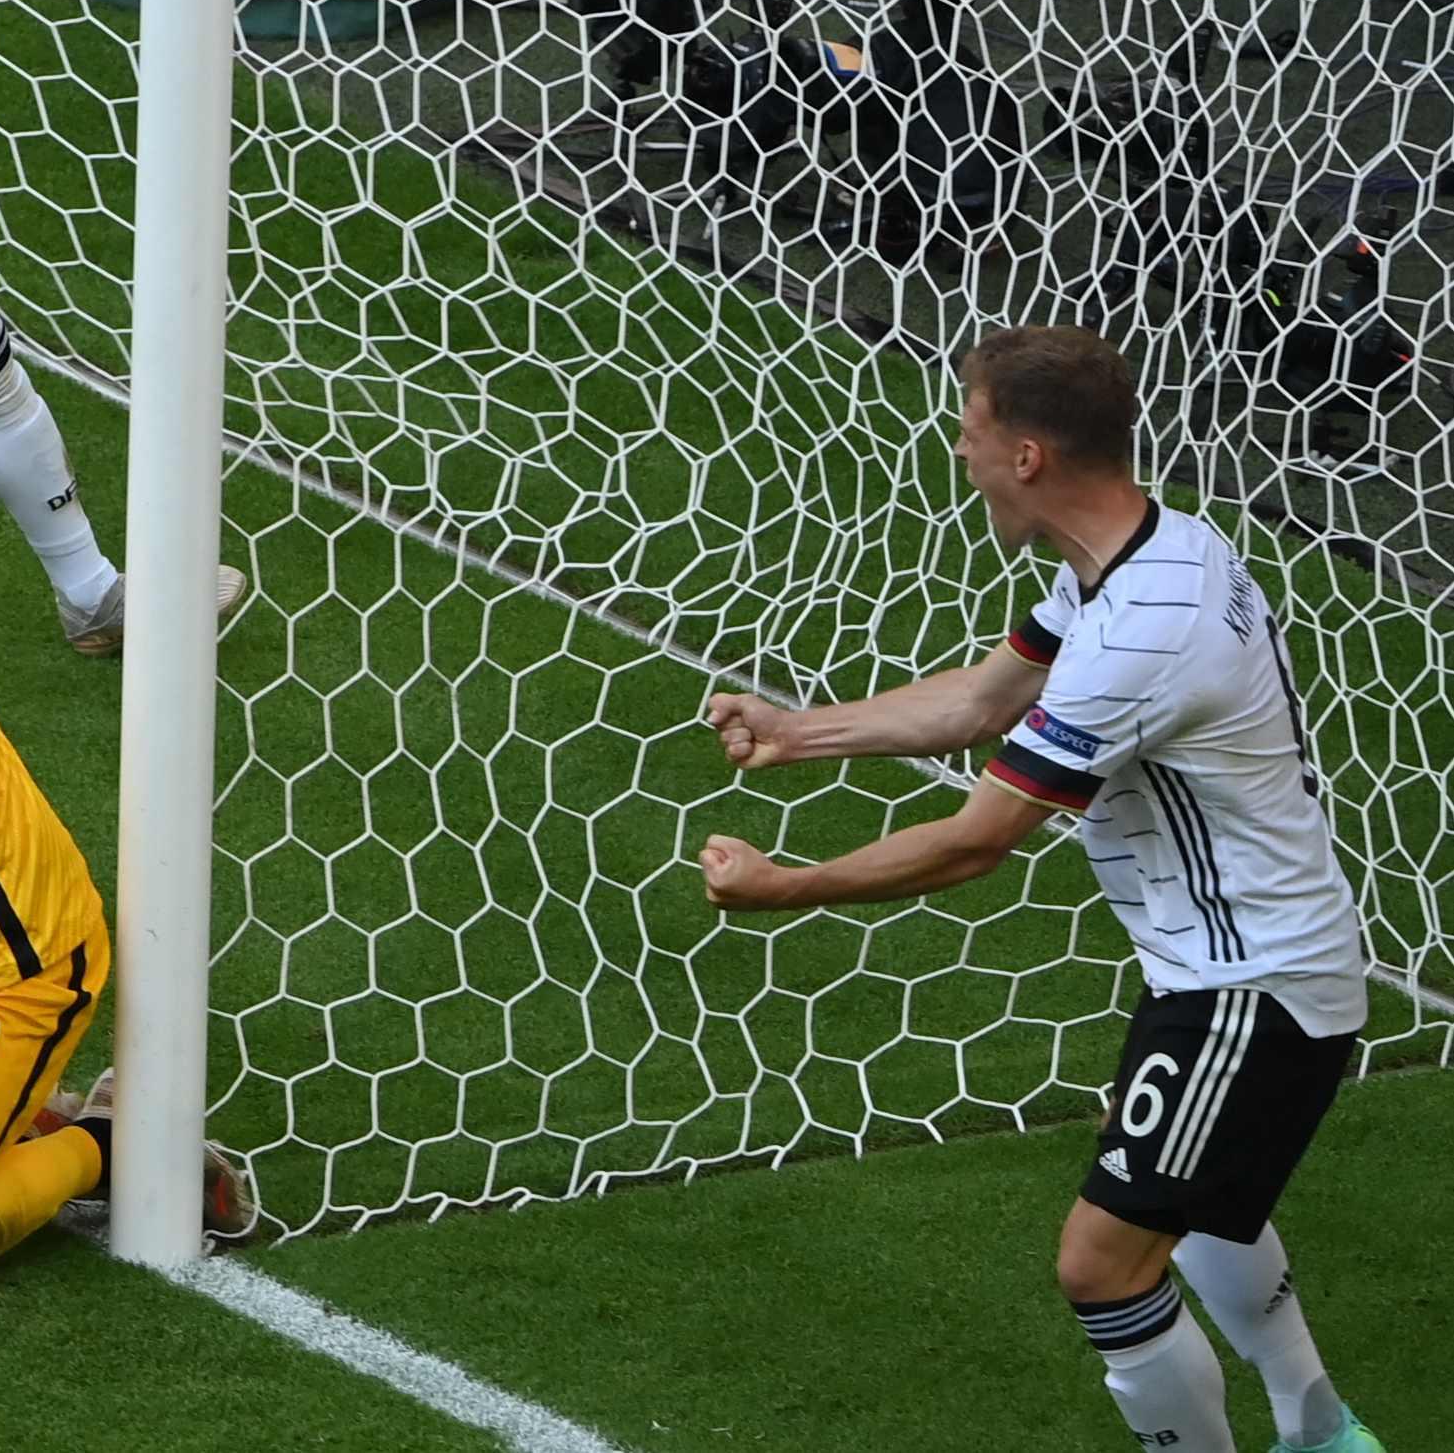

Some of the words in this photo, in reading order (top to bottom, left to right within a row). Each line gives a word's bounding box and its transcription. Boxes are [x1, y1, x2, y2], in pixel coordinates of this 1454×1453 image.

[47, 481, 78, 512] DF
[1043, 722, 1101, 756] RESPECT
[1121, 1052, 1181, 1138] 6
[1136, 1428, 1181, 1448] FB
